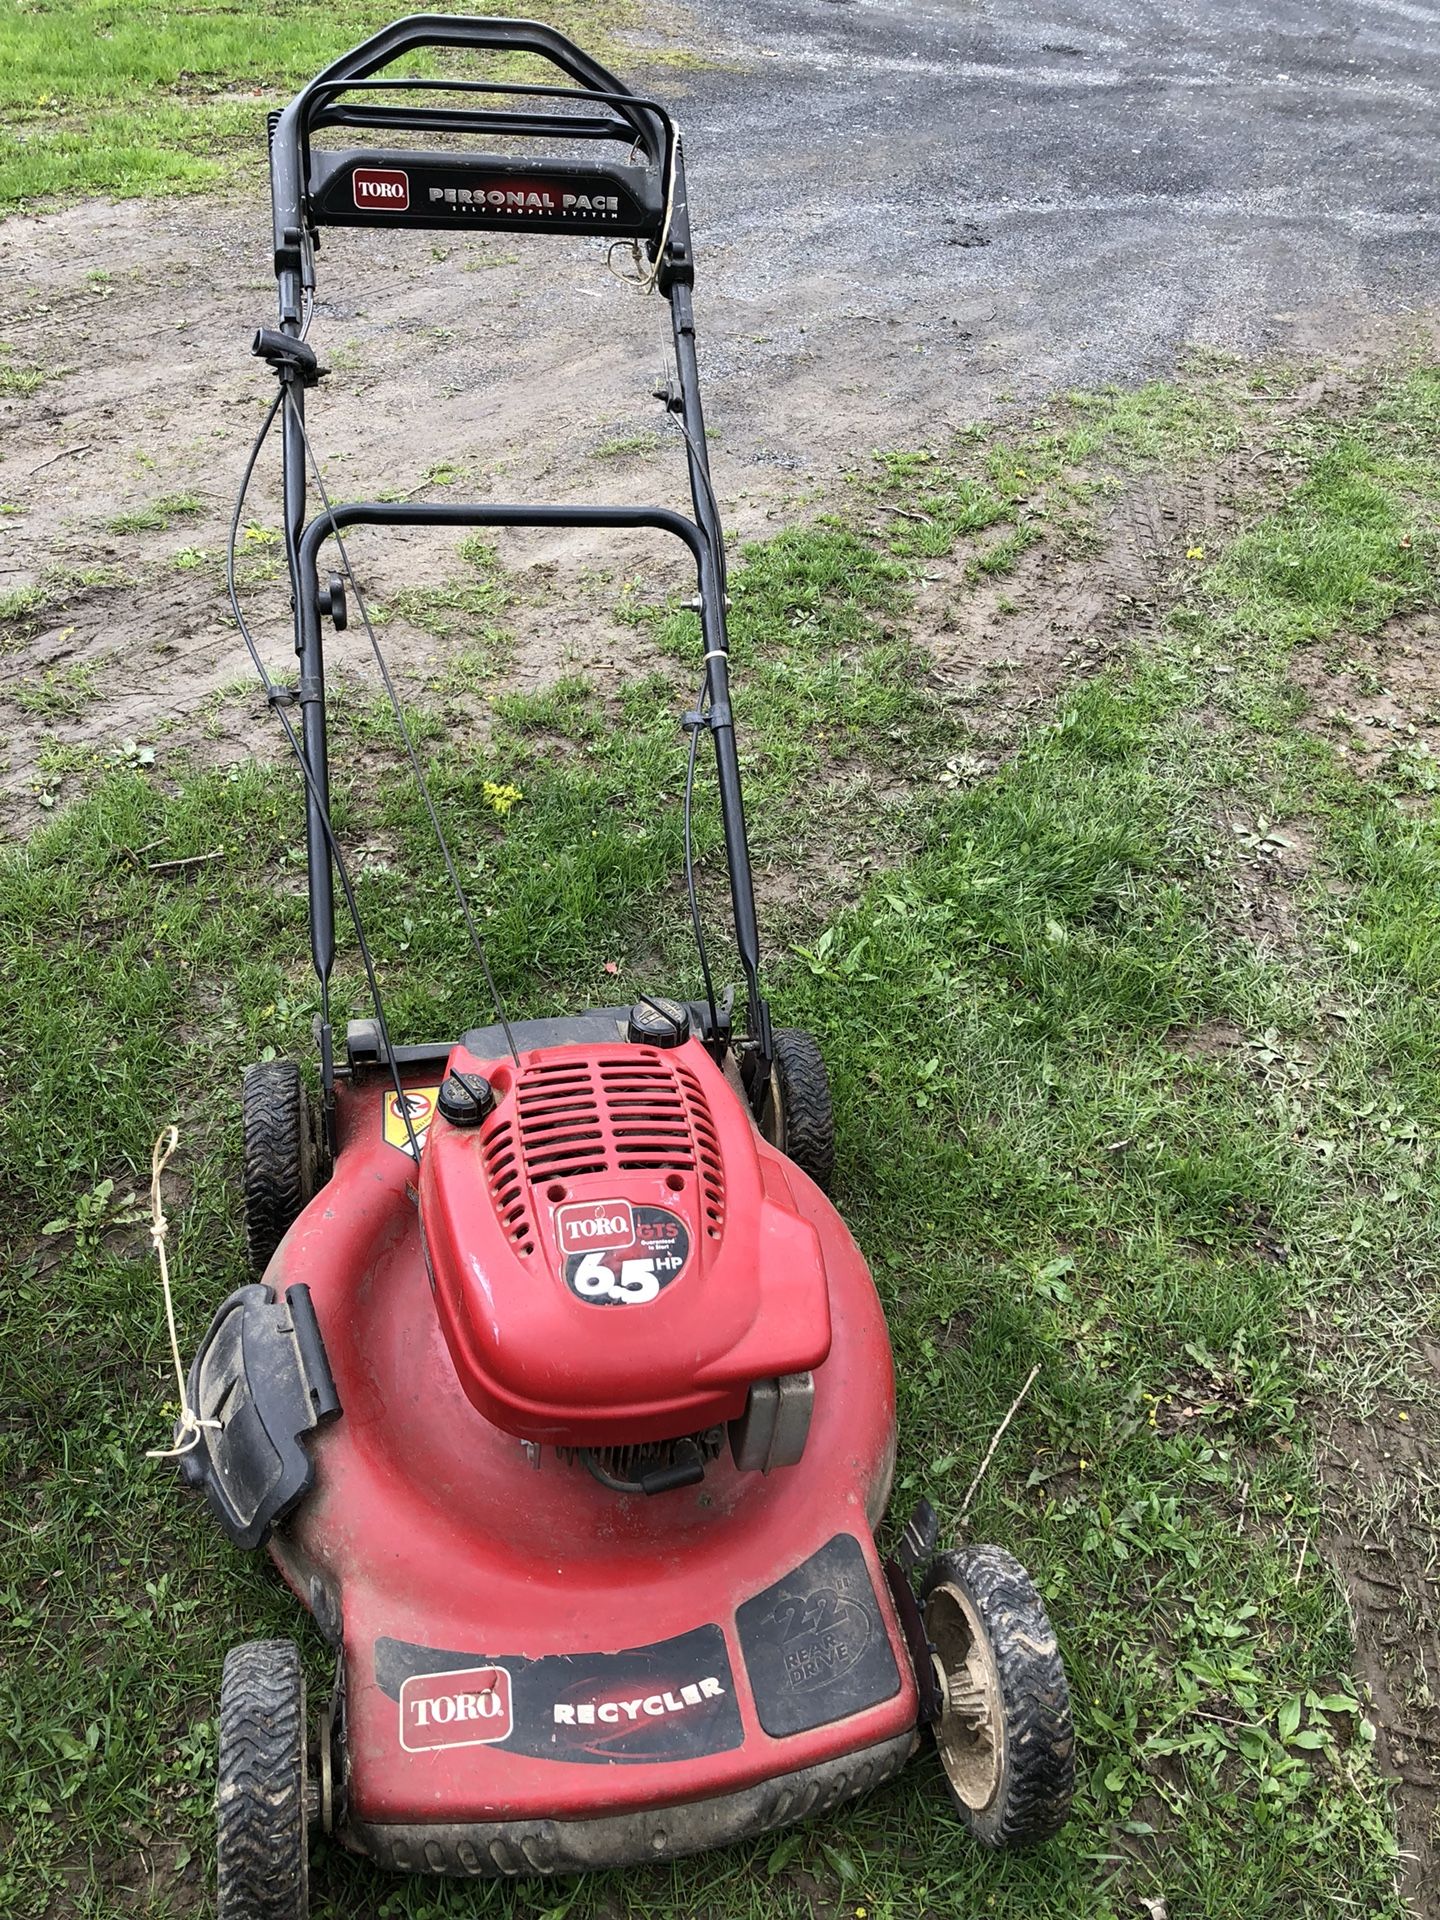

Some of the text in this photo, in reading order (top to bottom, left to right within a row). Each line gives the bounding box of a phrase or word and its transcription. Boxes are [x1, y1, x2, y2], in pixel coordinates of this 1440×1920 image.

[358, 181, 405, 199] TORO
[429, 187, 618, 211] PERSONAL PACE
[452, 205, 618, 219] SELF PROPEL SYSTEM
[566, 1215, 629, 1239] TORO
[636, 1221, 679, 1239] GTS
[574, 1252, 683, 1304] 6.5 HP
[783, 1632, 837, 1672] REAR
[787, 1642, 849, 1688] DRIVE
[410, 1688, 504, 1726] TORO
[553, 1677, 726, 1725] RECYCLER
